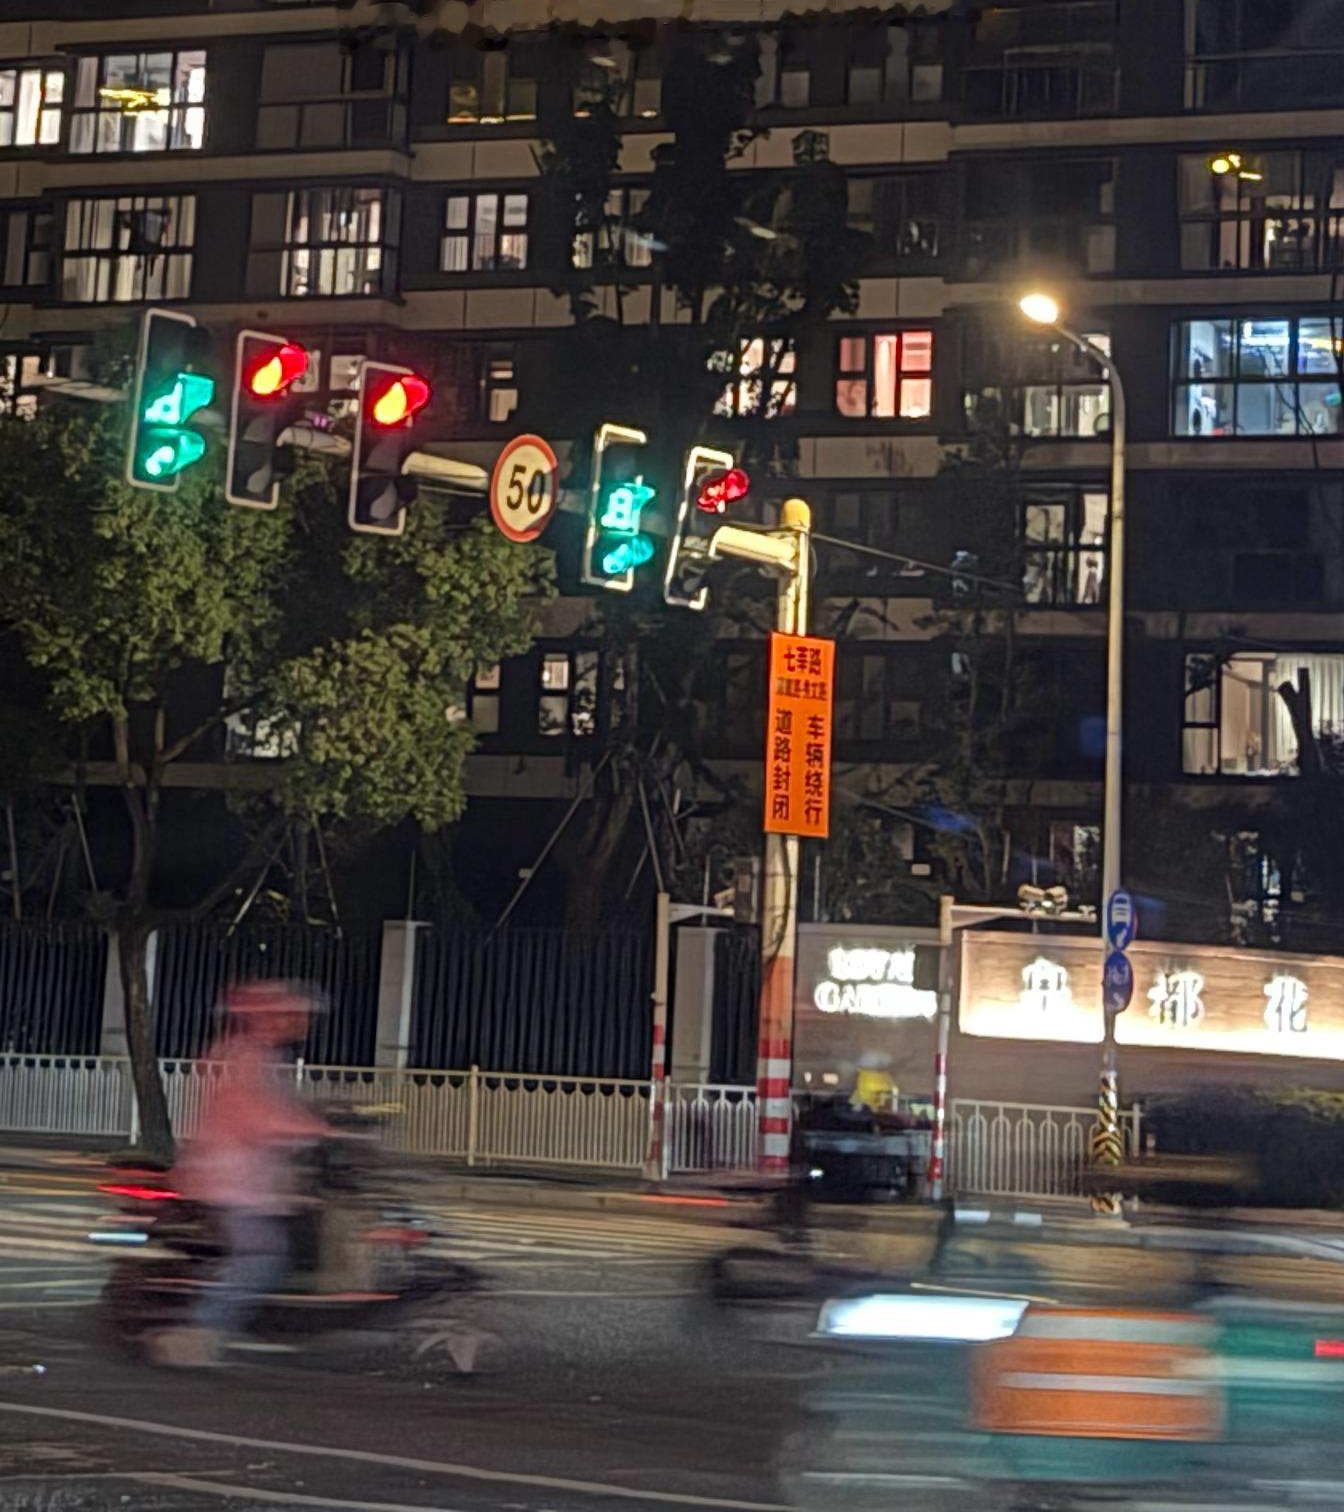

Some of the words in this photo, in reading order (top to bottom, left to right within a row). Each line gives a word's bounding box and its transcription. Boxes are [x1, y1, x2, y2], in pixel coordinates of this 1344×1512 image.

[506, 464, 546, 513] 50
[773, 708, 792, 820] 道路封闭
[805, 715, 824, 825] 车辆绕行
